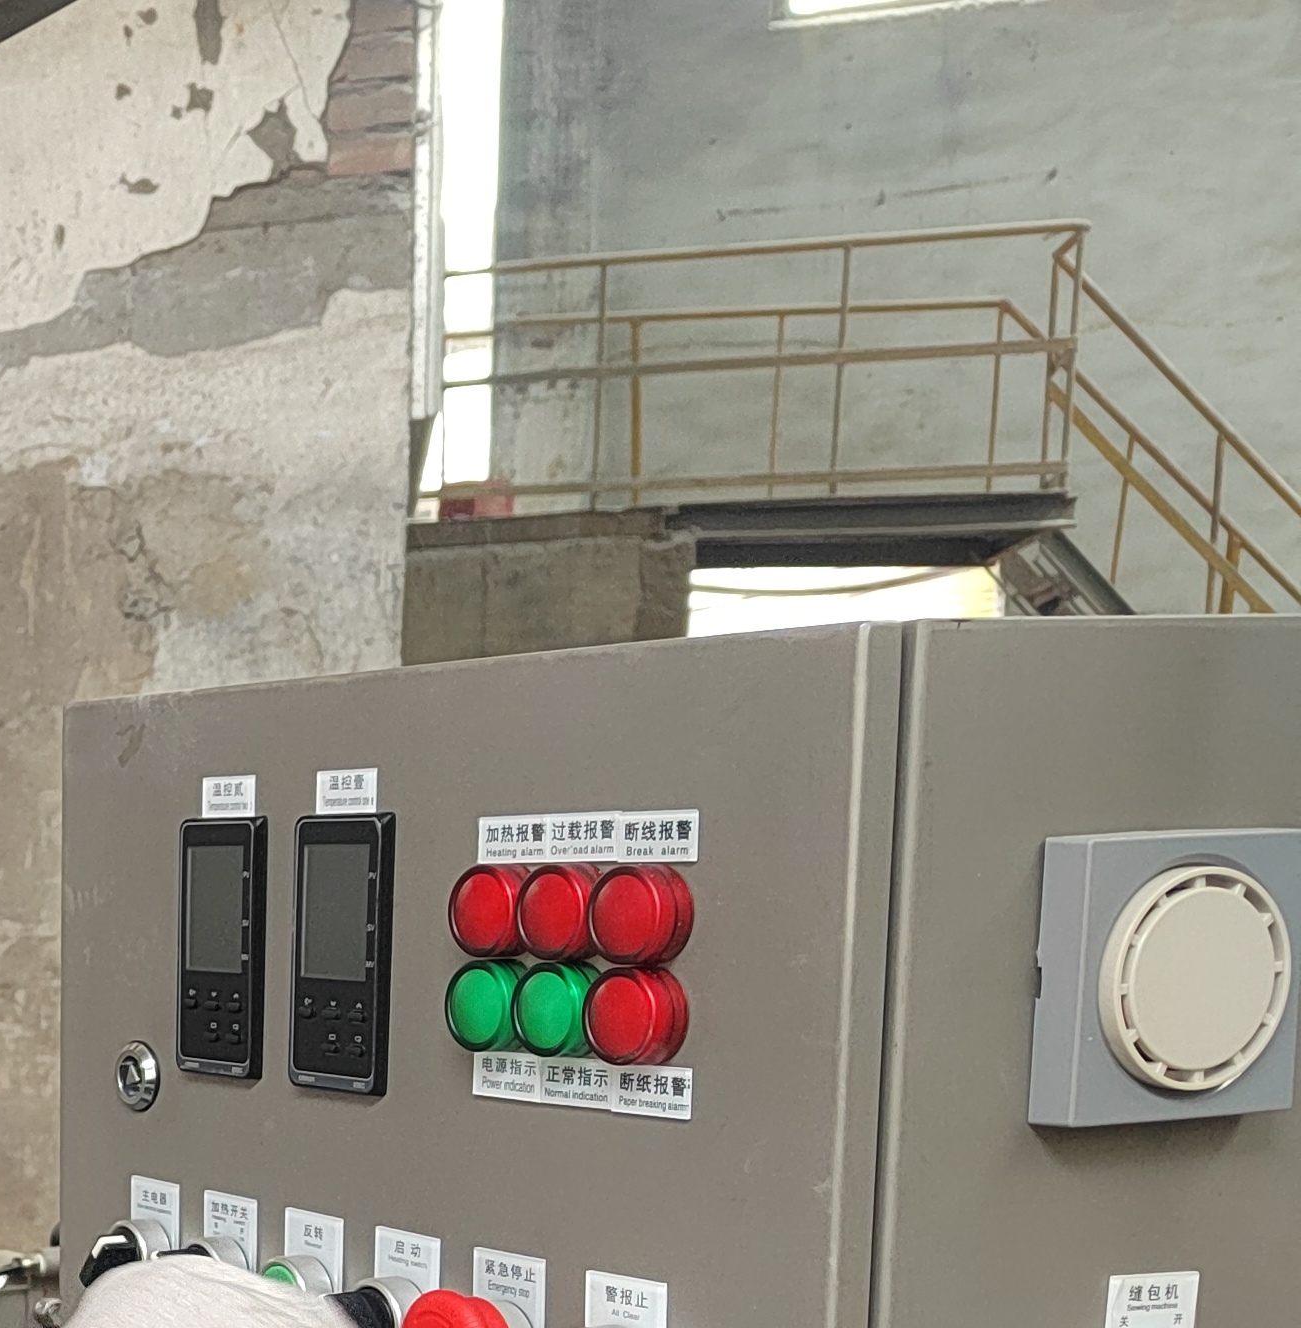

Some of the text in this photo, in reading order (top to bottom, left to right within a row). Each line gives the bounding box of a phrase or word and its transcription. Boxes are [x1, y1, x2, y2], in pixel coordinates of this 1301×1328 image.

[329, 774, 365, 791] 温控壹
[485, 823, 545, 843] 加热报警
[551, 820, 615, 841] 过载报警
[624, 819, 692, 841] 断线报警
[486, 847, 544, 859] Heating alarm
[591, 845, 614, 855] alarm
[626, 845, 689, 857] Break alarm
[481, 1056, 537, 1077] 电源指示
[482, 1075, 535, 1094] Power indication
[546, 1065, 609, 1088] 正常指示
[619, 1072, 687, 1098] 断纸报警
[545, 1087, 608, 1103] Normal indication
[619, 1095, 638, 1108] Paper
[639, 1097, 667, 1112] breaking
[211, 1201, 248, 1220] 加热开关
[303, 1224, 323, 1241] 反转
[394, 1240, 421, 1258] 启动
[485, 1259, 537, 1284] 紧急停止
[488, 1280, 530, 1299] Emergency stop
[605, 1285, 649, 1309] 警报止
[1129, 1284, 1179, 1302] 缝包机
[623, 1310, 640, 1321] Clear
[1127, 1302, 1178, 1312] Sewing machine
[1119, 1314, 1183, 1327] 关 开
